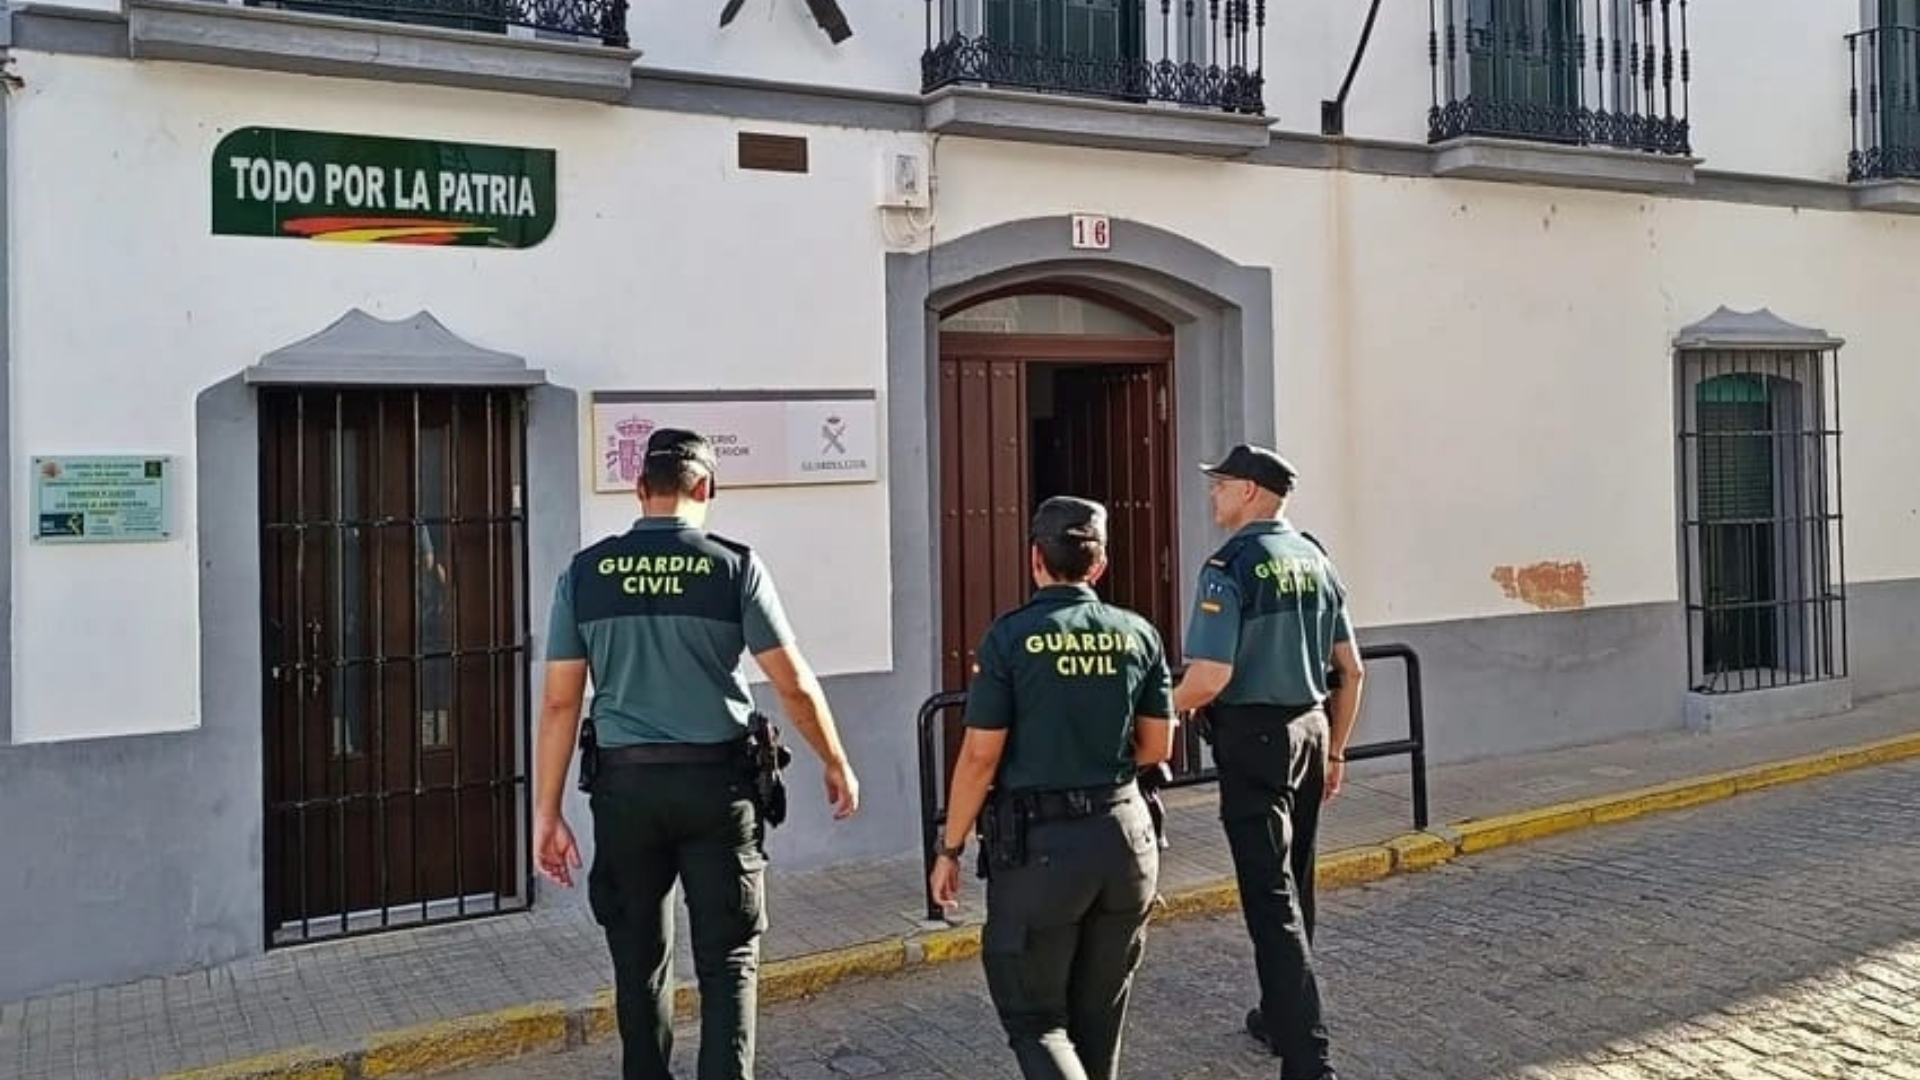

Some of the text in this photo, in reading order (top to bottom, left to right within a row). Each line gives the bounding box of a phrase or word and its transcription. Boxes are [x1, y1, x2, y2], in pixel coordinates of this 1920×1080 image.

[230, 156, 537, 217] TODO POR LA PATRIA
[1074, 219, 1106, 246] 16
[598, 556, 711, 575] GUARDIA
[622, 575, 684, 594] CIVIL
[1025, 632, 1139, 654] GUARDIA
[1056, 655, 1118, 676] CIVIL
